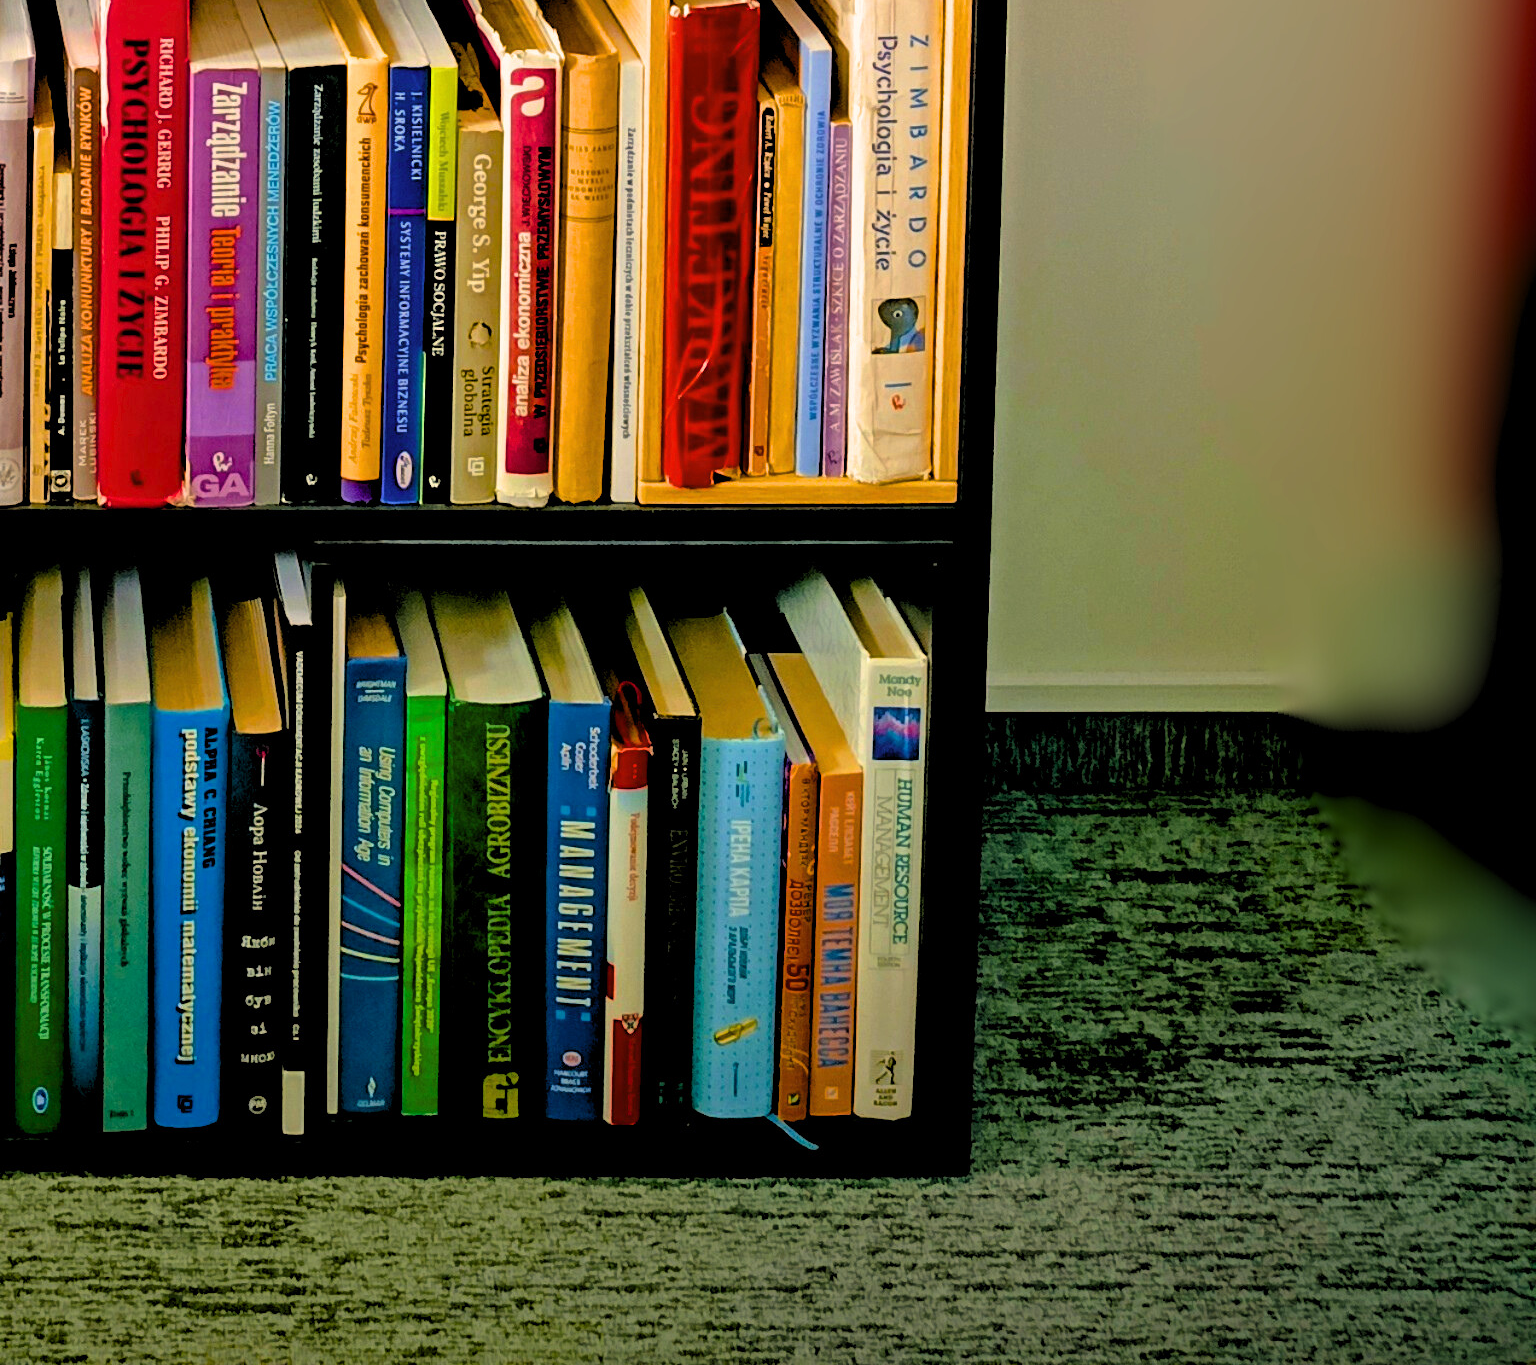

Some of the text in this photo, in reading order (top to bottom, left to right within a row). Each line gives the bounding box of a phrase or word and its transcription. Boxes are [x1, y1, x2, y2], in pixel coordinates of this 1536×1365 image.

[872, 36, 898, 176] Psychologia
[906, 34, 929, 270] ZIMBARDO
[116, 38, 153, 379] PSYCHOLOGIA I ŻYCIE
[152, 37, 174, 379] RICHARD J. GERRIG PHILIP G. ZIMBARDO
[467, 153, 491, 293] George S. Yip
[872, 210, 896, 271] życie
[431, 231, 447, 357] PRAWO SOCJALNE
[461, 368, 476, 437] globalna
[480, 365, 495, 436] Strategia
[886, 686, 911, 698] Noe
[176, 729, 198, 1062] podstawy ekonomii matematycznej
[486, 722, 512, 1062] ENCYKLOPEDIA AGROBIZNESU
[556, 819, 596, 1007] MANAGEMENT
[892, 778, 912, 944] HUMAN RESOURCE
